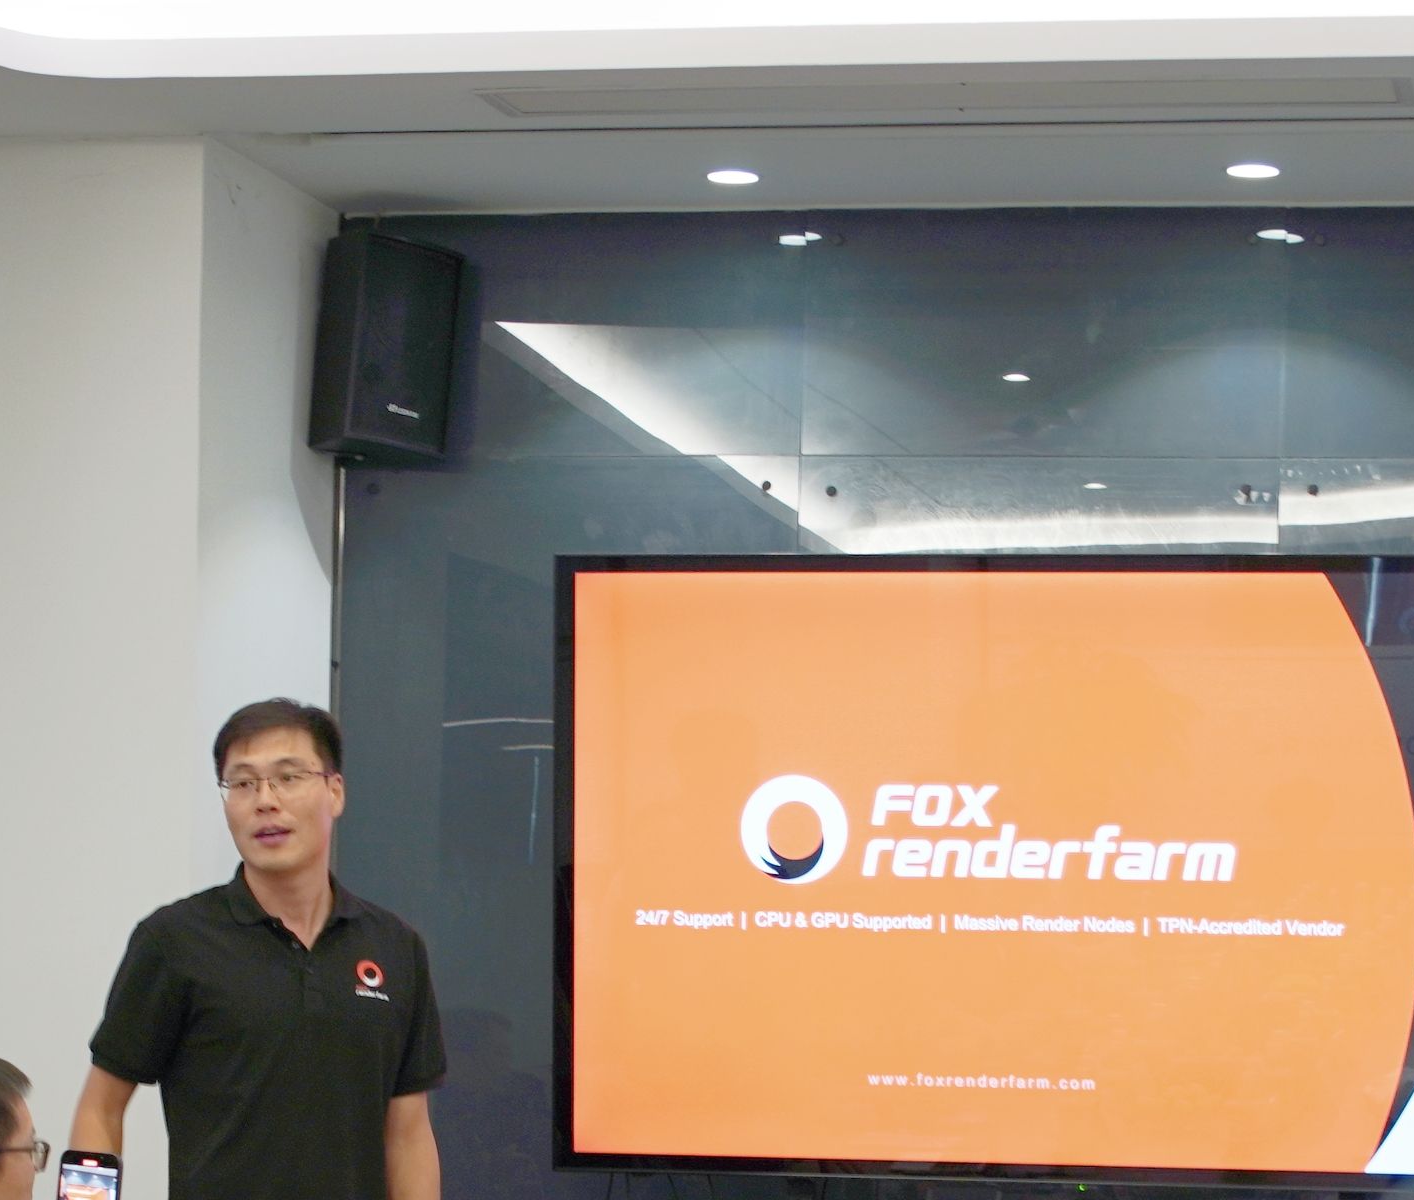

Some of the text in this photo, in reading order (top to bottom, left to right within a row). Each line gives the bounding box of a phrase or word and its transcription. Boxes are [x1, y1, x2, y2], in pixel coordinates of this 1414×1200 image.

[870, 783, 1000, 828] FOX
[862, 823, 1238, 882] renderfarm
[635, 908, 1346, 937] 24/7 Support CPU & GPU Supported Massive Render Nodes TPN-Accredited Vendor
[867, 1072, 1096, 1090] www.foxrenderfarm.com
